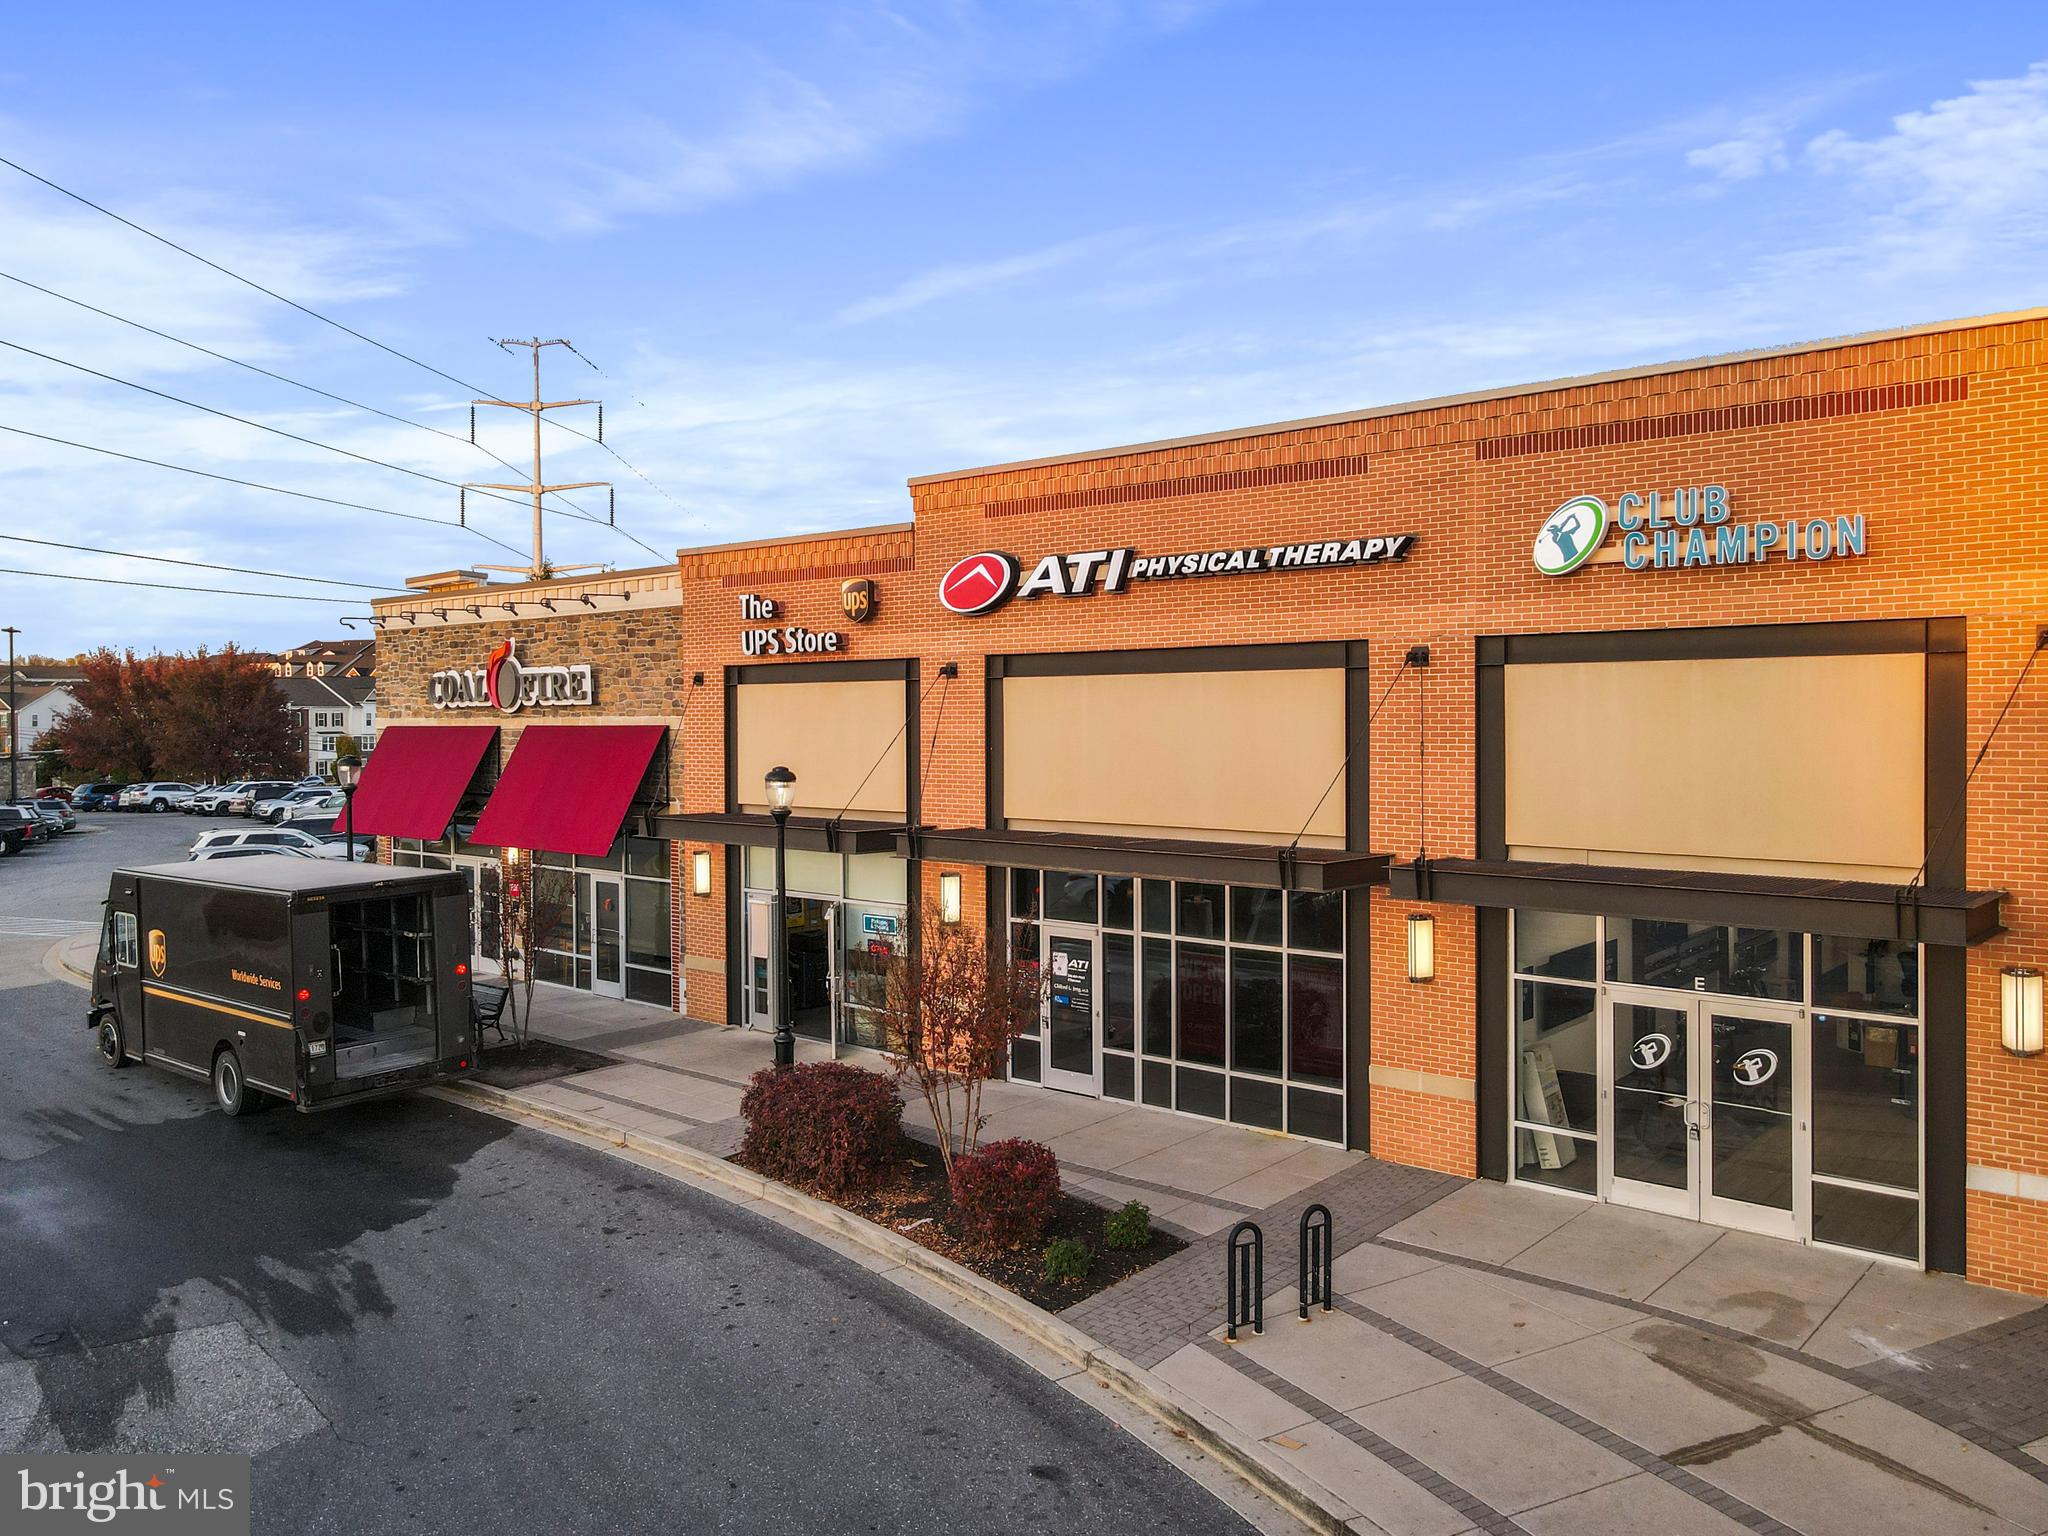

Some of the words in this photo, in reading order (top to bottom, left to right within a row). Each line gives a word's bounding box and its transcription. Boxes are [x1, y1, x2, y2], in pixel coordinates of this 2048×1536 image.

[1617, 485, 1730, 531] CLUB
[1623, 514, 1867, 570] CHAMPION
[1017, 548, 1126, 597] ATI
[1131, 548, 1261, 578] PHYSICAL
[1266, 536, 1408, 567] THERAPY
[738, 594, 773, 619] The
[843, 591, 867, 617] ups
[741, 628, 779, 656] UPS
[785, 627, 838, 654] Store
[427, 671, 491, 706] COAL
[518, 670, 589, 702] FIRE
[151, 944, 165, 970] ups
[1068, 959, 1089, 970] ATI
[231, 968, 259, 985] Worldwide
[259, 974, 282, 990] Services
[1694, 976, 1706, 991] E
